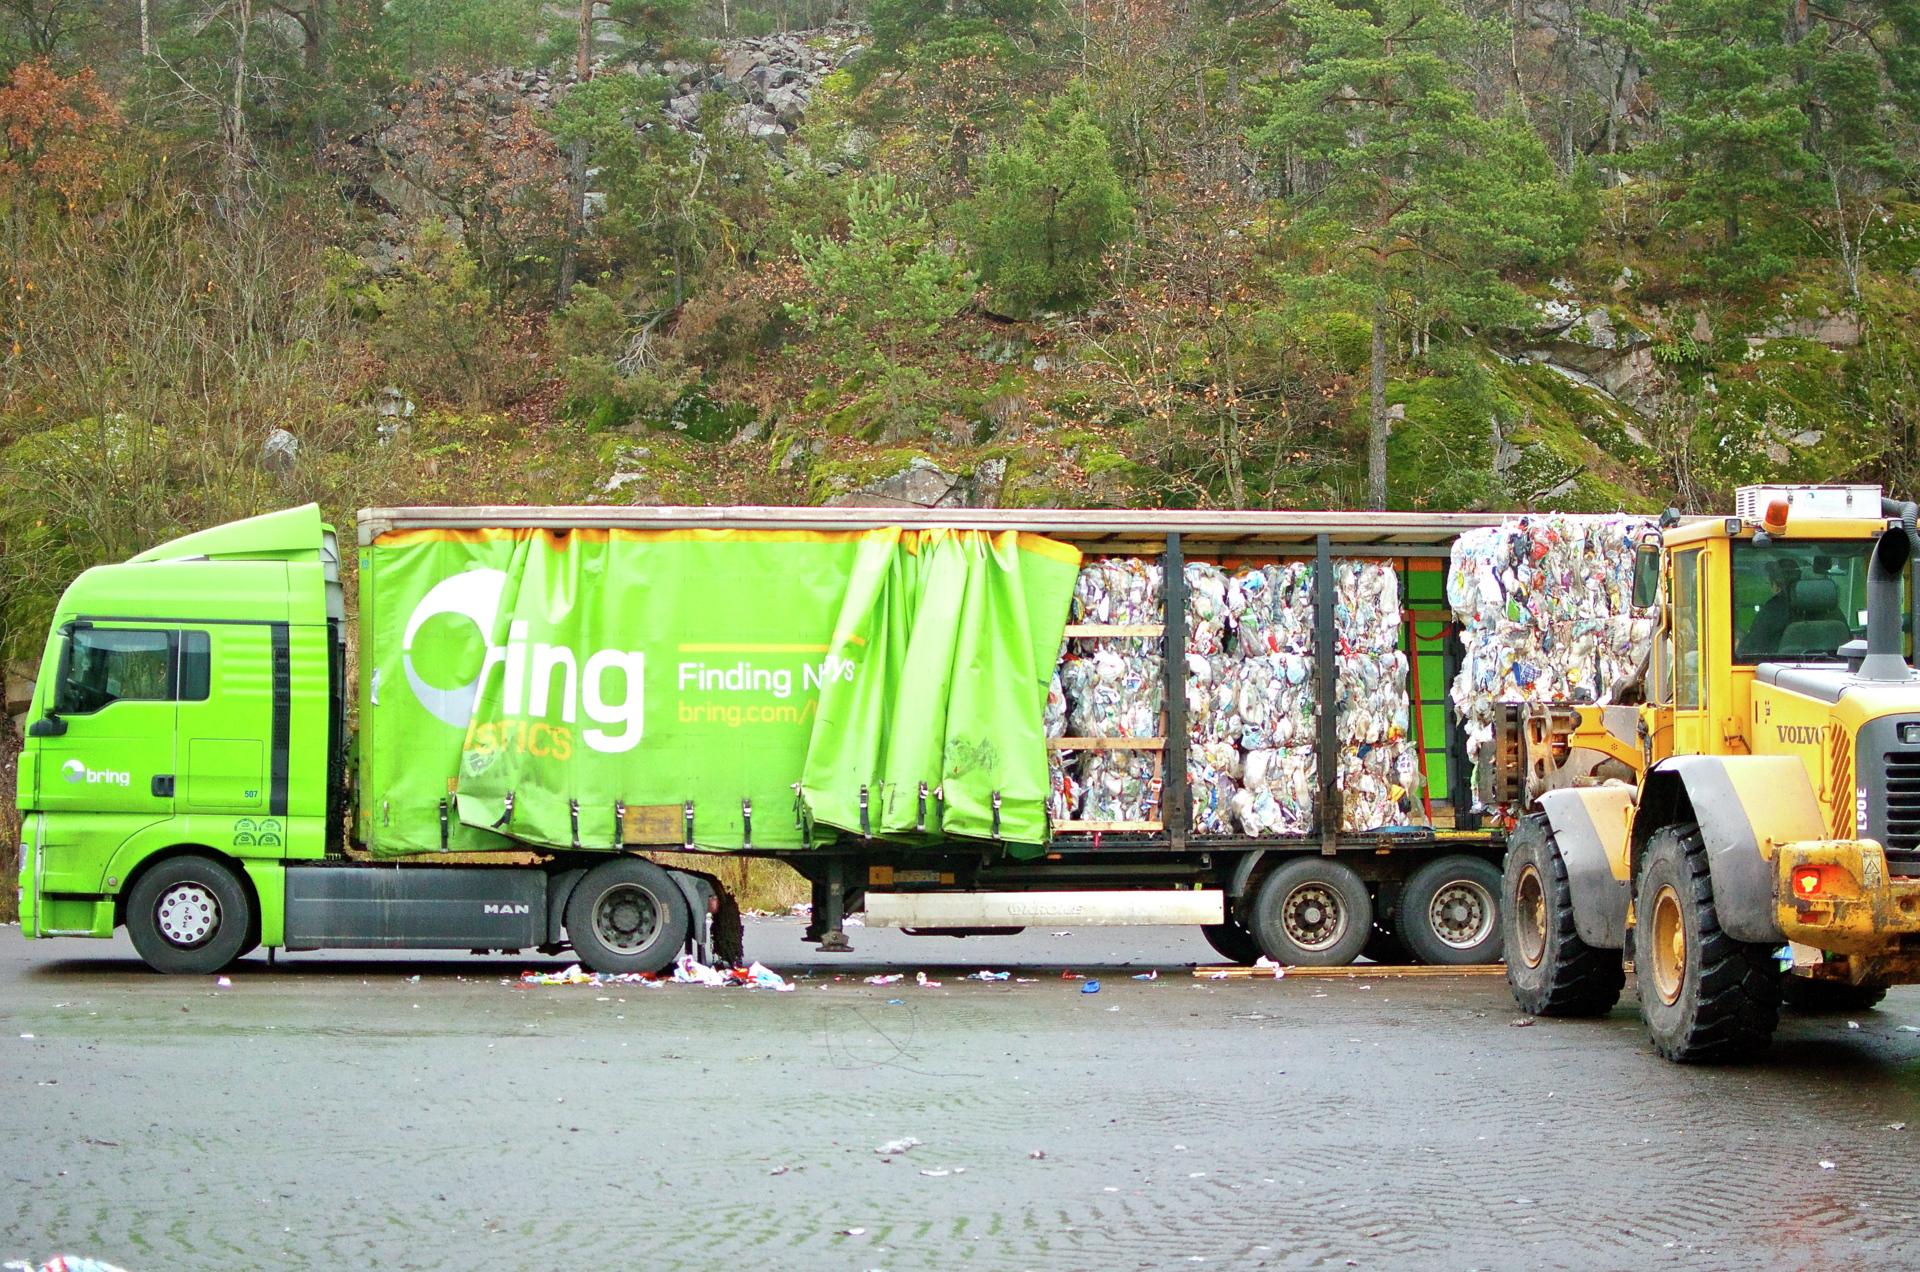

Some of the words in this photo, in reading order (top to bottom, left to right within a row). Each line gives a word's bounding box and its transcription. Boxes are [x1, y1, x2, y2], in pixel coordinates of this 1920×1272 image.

[678, 661, 792, 698] Finding
[463, 718, 572, 761] ISTICS
[86, 768, 130, 786] bring
[244, 790, 258, 798] 507
[182, 906, 190, 929] MAN
[484, 904, 529, 914] MAN
